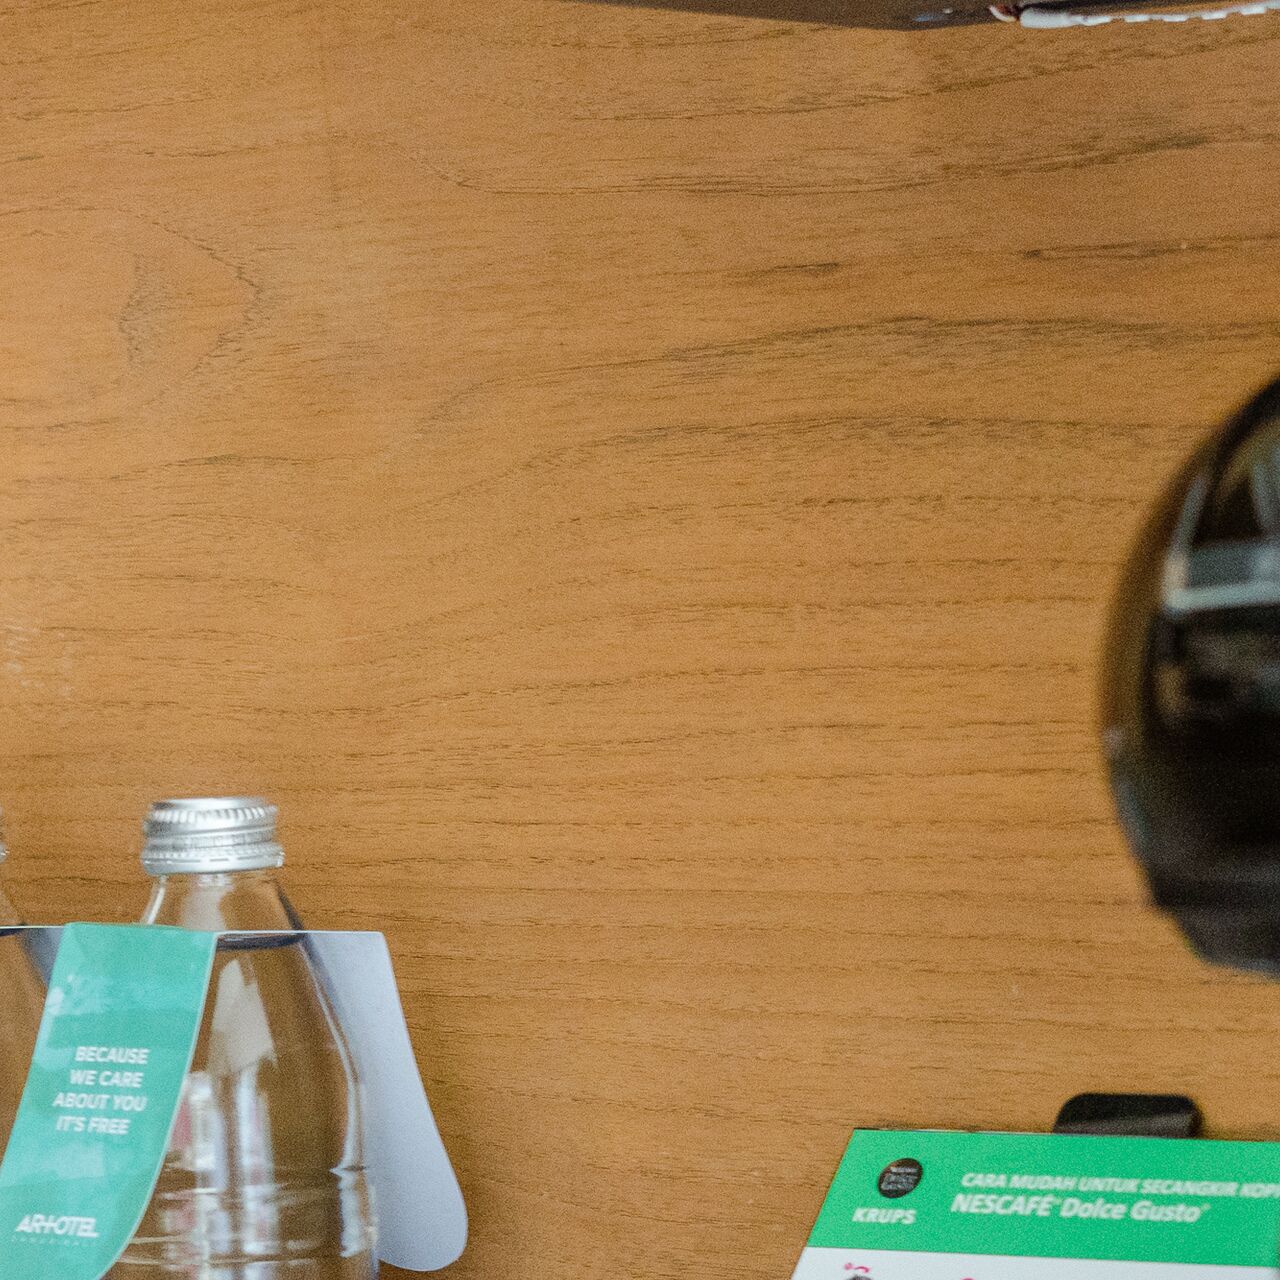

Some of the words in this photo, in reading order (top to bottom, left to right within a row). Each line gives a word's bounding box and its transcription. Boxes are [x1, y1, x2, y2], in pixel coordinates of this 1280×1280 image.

[75, 1046, 150, 1065] BECAUSE
[70, 1069, 97, 1085] WE
[99, 1070, 144, 1088] CARE
[52, 1092, 111, 1109] ABOUT
[112, 1094, 148, 1111] YOU
[87, 1117, 131, 1134] FREE
[961, 1173, 1008, 1188] CARA
[1009, 1174, 1076, 1190] MUDAH
[1078, 1176, 1140, 1193] UNTUK
[852, 1207, 917, 1224] KRUPS
[1060, 1197, 1127, 1219] Dolce
